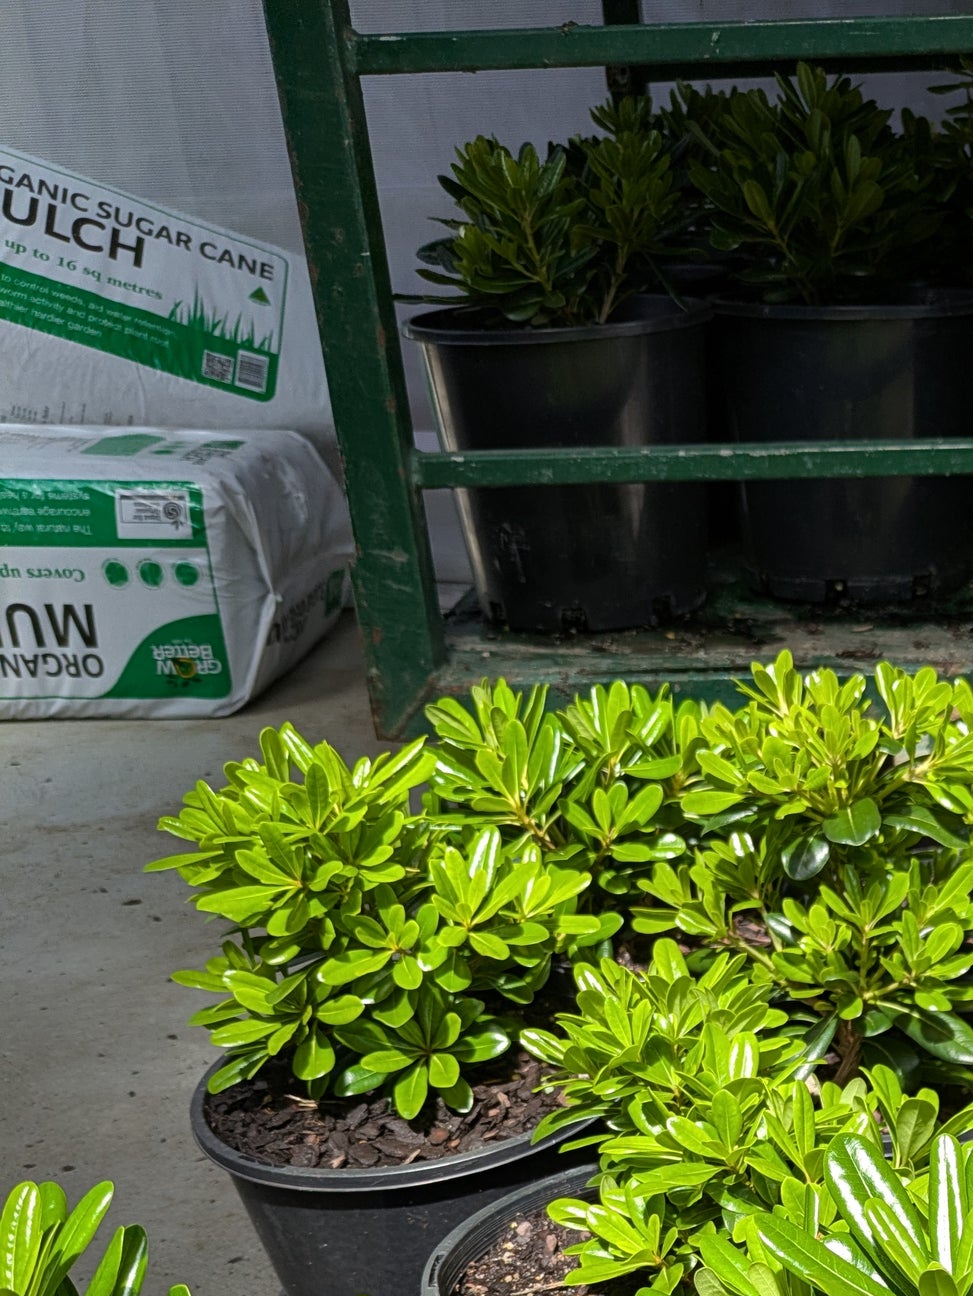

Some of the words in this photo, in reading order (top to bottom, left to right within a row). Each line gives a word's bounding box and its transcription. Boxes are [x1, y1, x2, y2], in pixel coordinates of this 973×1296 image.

[0, 165, 90, 212] GANIC
[96, 200, 192, 252] SUGAR
[199, 241, 275, 281] CANE
[2, 187, 145, 269] ULCH
[5, 239, 27, 255] up
[32, 248, 50, 261] to
[58, 257, 77, 272] 16
[82, 266, 102, 283] sq
[106, 276, 163, 300] metres
[13, 278, 49, 294] control
[37, 506, 91, 517] encourage
[13, 521, 34, 533] way
[35, 523, 71, 533] natural
[72, 524, 93, 536] The
[0, 563, 22, 579] up
[26, 568, 86, 583] Covers
[0, 602, 99, 648] MU
[0, 653, 104, 679] ORGAN
[157, 659, 222, 678] GROW
